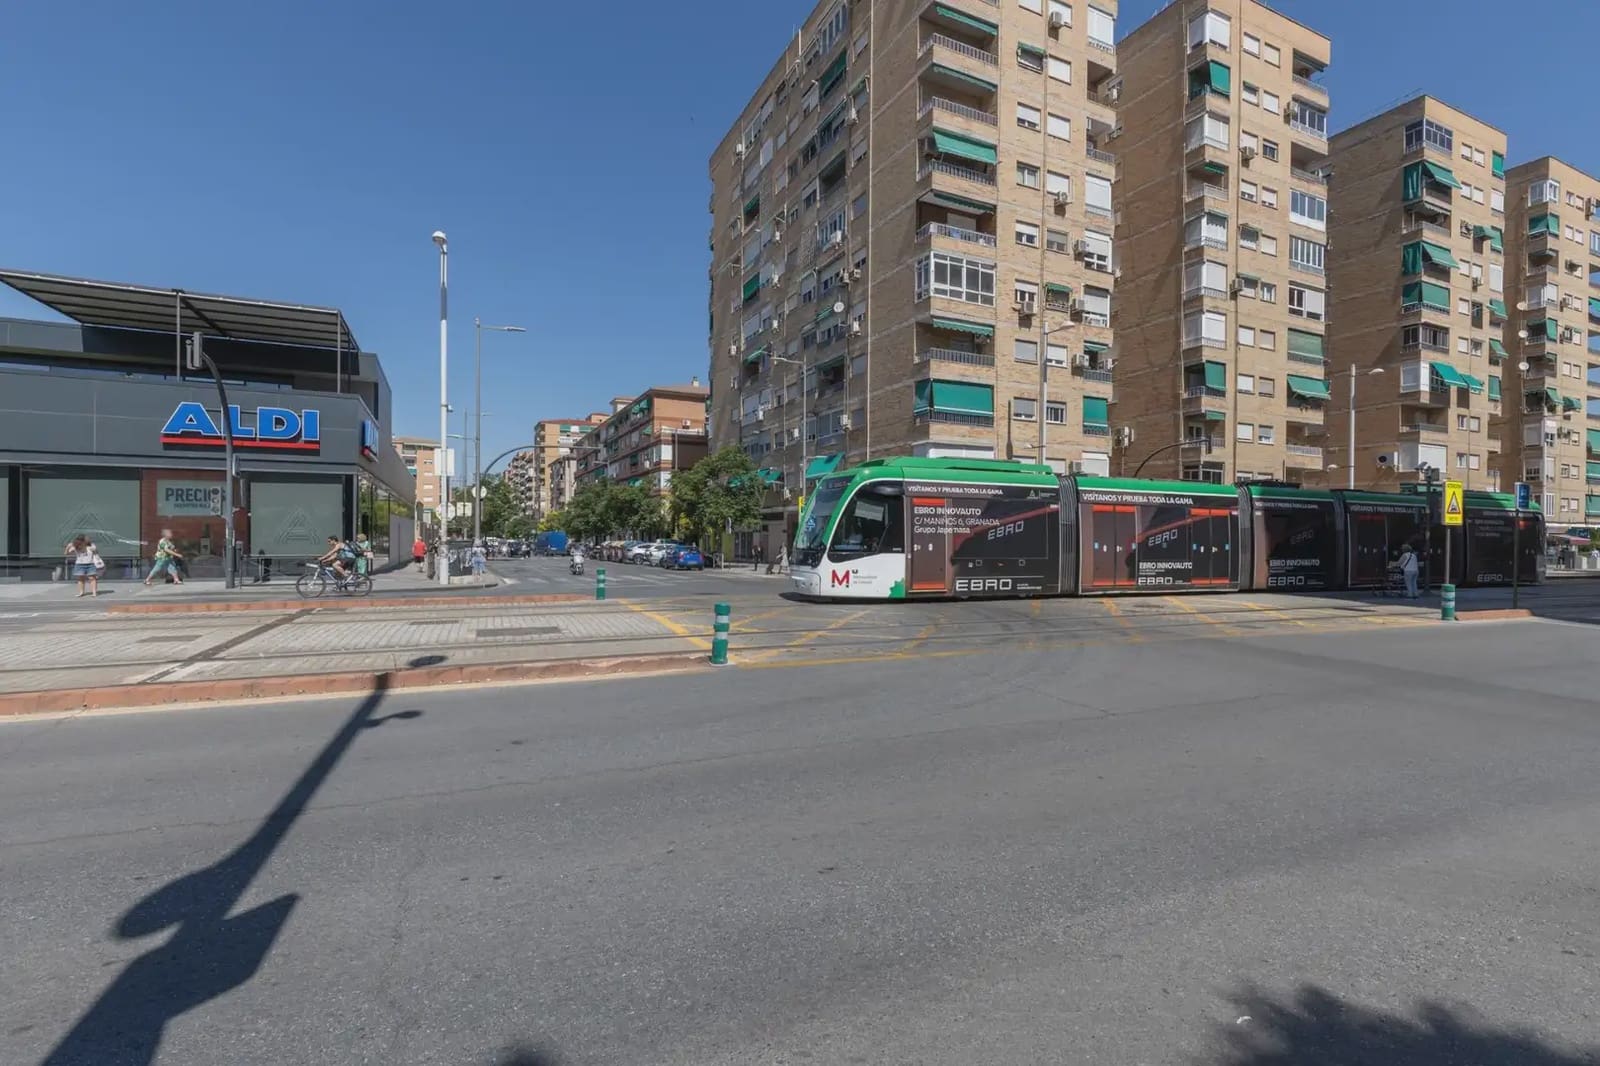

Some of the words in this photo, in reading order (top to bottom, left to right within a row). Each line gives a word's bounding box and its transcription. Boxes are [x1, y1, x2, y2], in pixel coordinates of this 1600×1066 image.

[161, 401, 320, 441] ALDI
[1122, 494, 1148, 503] PRUEBA
[1175, 497, 1194, 505] GAMA
[914, 507, 935, 515] EBRO
[937, 507, 981, 516] INNOVAUTO
[965, 517, 1000, 526] GRANADA
[914, 525, 936, 534] Grupo
[987, 520, 1024, 541] EBRO
[1148, 529, 1178, 546] EBRO
[831, 569, 850, 587] M
[1138, 576, 1173, 585] EBRO
[1268, 576, 1305, 586] EBRO
[1477, 574, 1503, 583] EBRO
[955, 579, 1012, 592] EBRO
